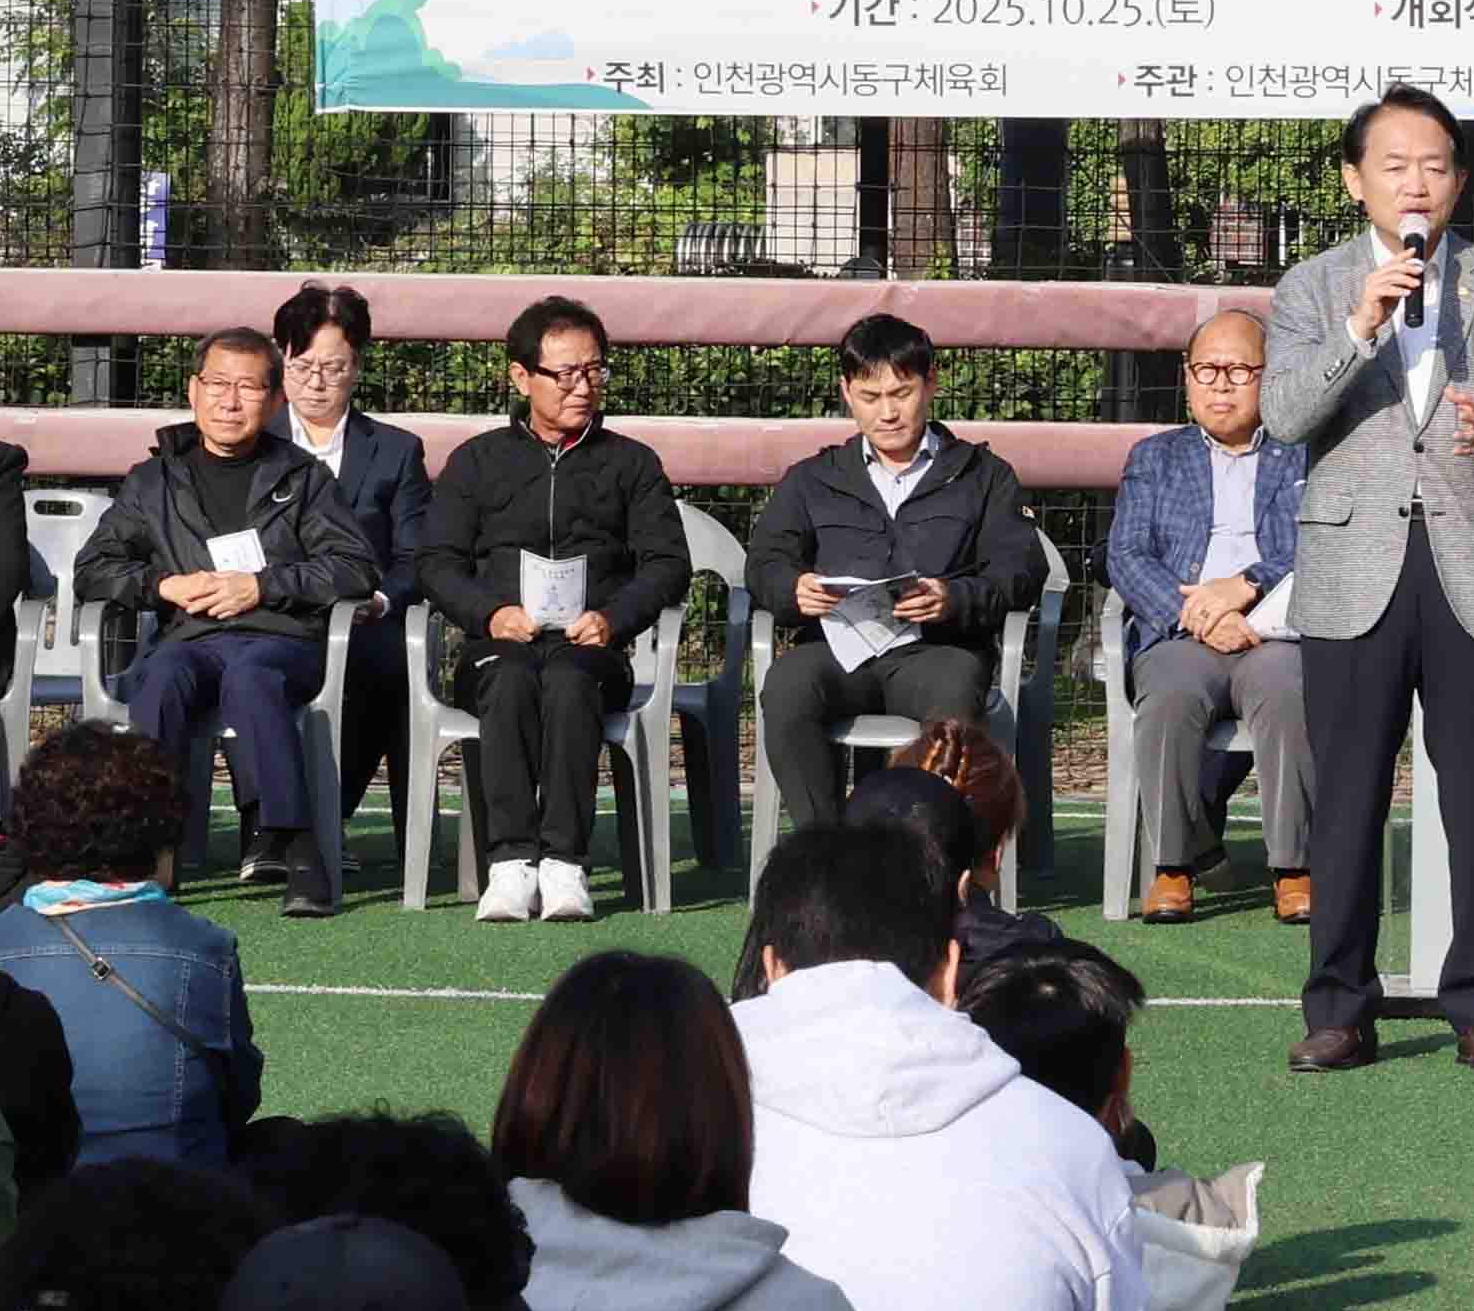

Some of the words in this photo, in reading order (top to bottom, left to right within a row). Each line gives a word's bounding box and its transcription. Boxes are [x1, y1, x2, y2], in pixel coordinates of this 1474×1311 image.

[603, 61, 665, 94] 주최
[693, 61, 1007, 98] 인천광역시동구체육회
[1133, 64, 1199, 99] 주관
